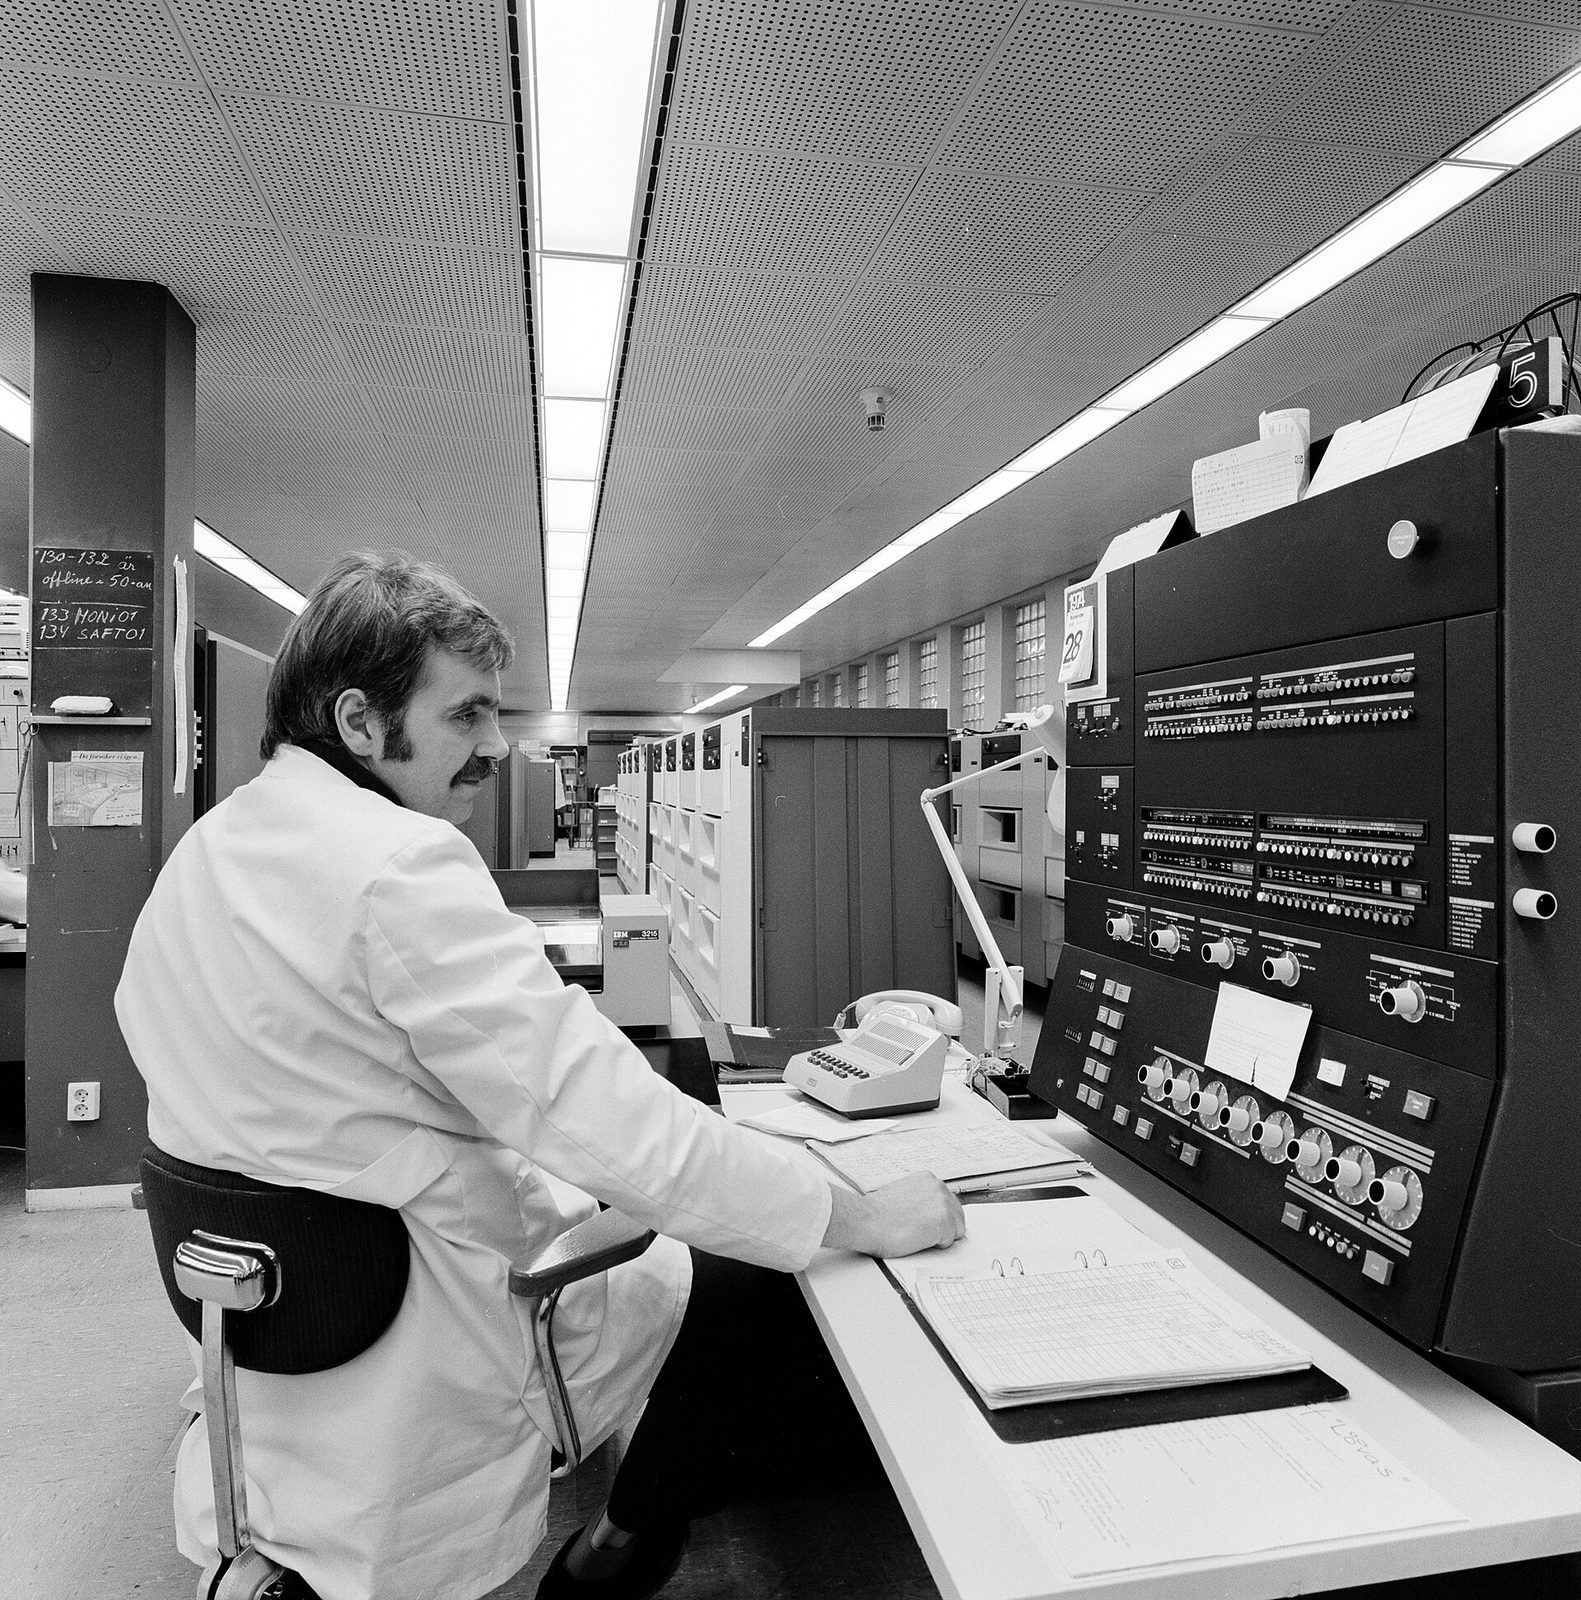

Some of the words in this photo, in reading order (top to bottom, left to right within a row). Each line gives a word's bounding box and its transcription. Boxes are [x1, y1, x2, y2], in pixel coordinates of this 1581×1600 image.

[1508, 351, 1538, 408] 5
[40, 550, 110, 566] 130-132
[117, 555, 136, 571] är
[42, 570, 93, 589] offline
[41, 607, 70, 621] 133
[40, 624, 70, 640] 134
[77, 627, 146, 641] SAFT01
[1063, 629, 1083, 665] 28
